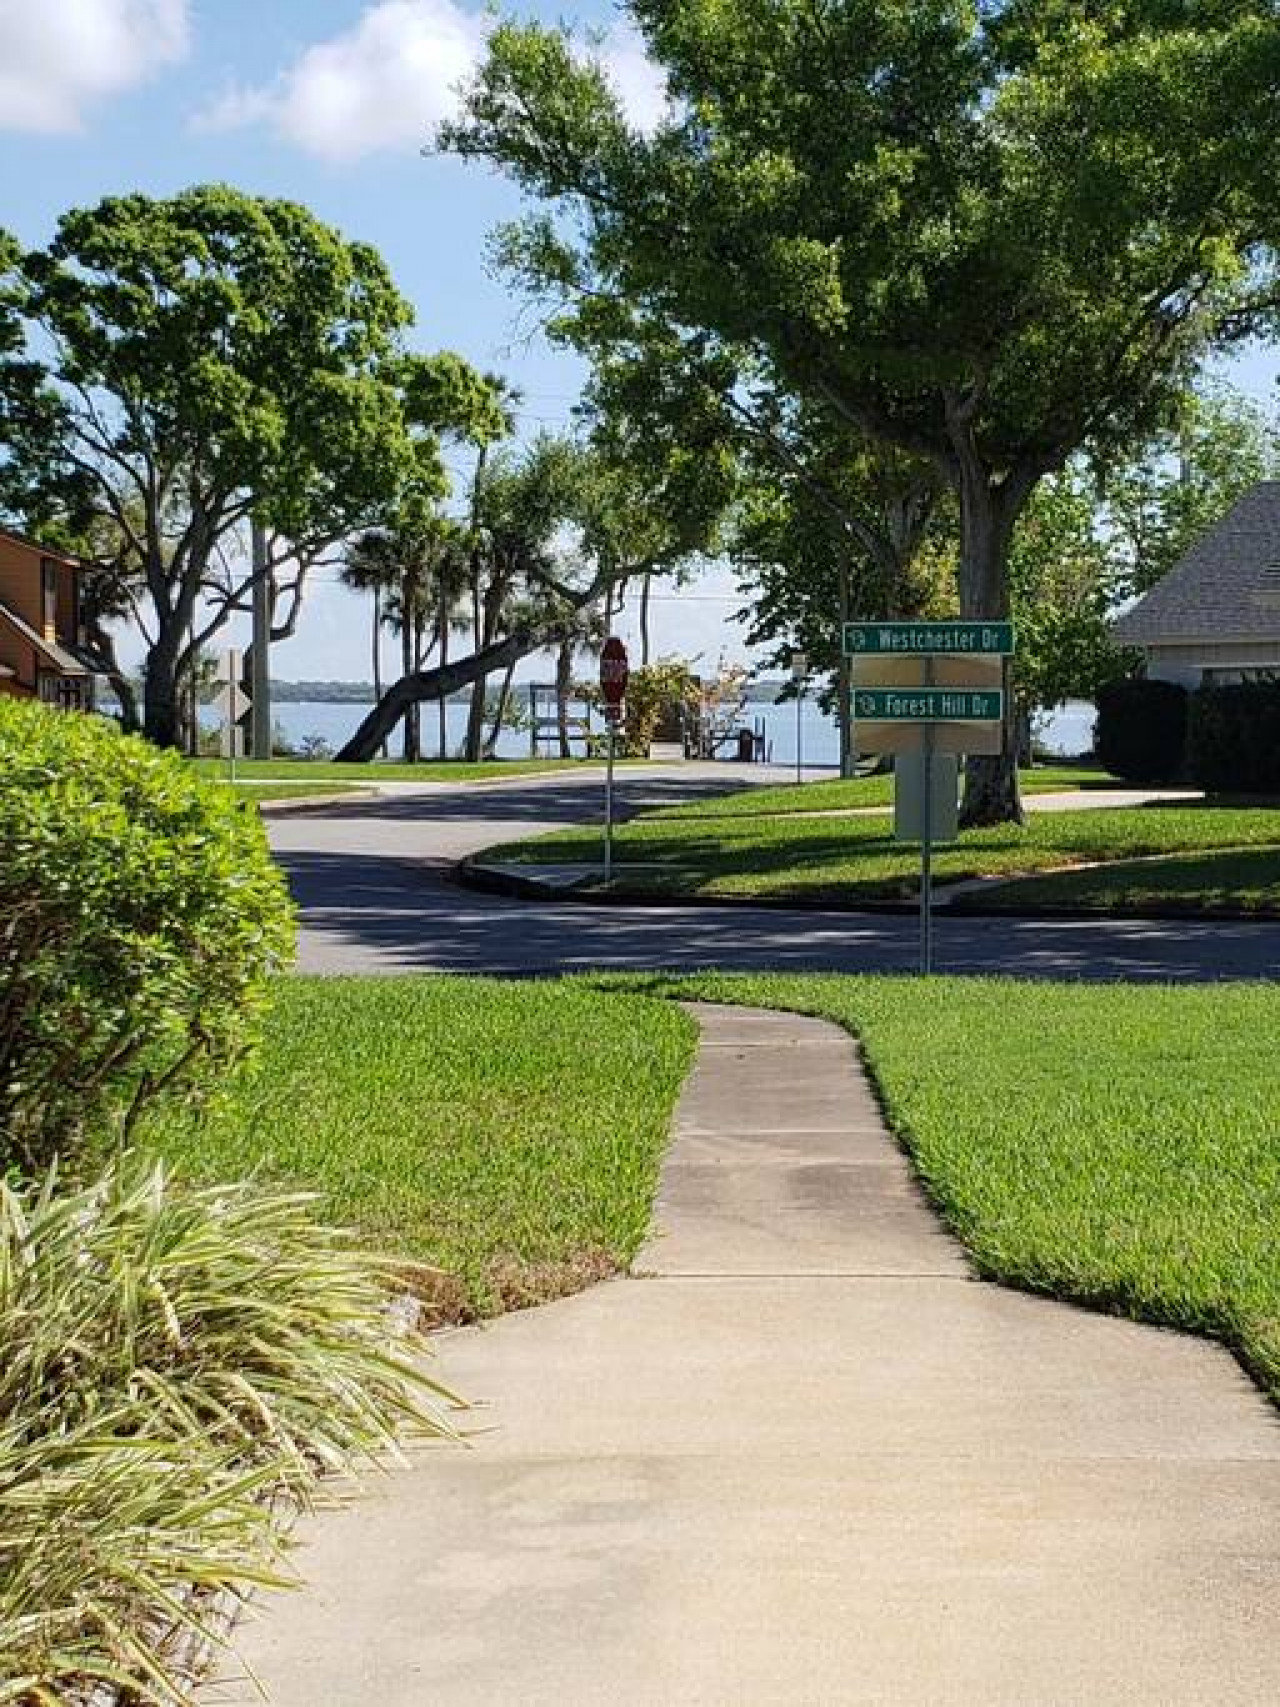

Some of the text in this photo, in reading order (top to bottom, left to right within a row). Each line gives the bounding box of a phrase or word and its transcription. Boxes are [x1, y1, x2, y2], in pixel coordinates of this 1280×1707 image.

[879, 629, 999, 648] Westchester Dr
[886, 694, 989, 715] Forest Hill Dr
